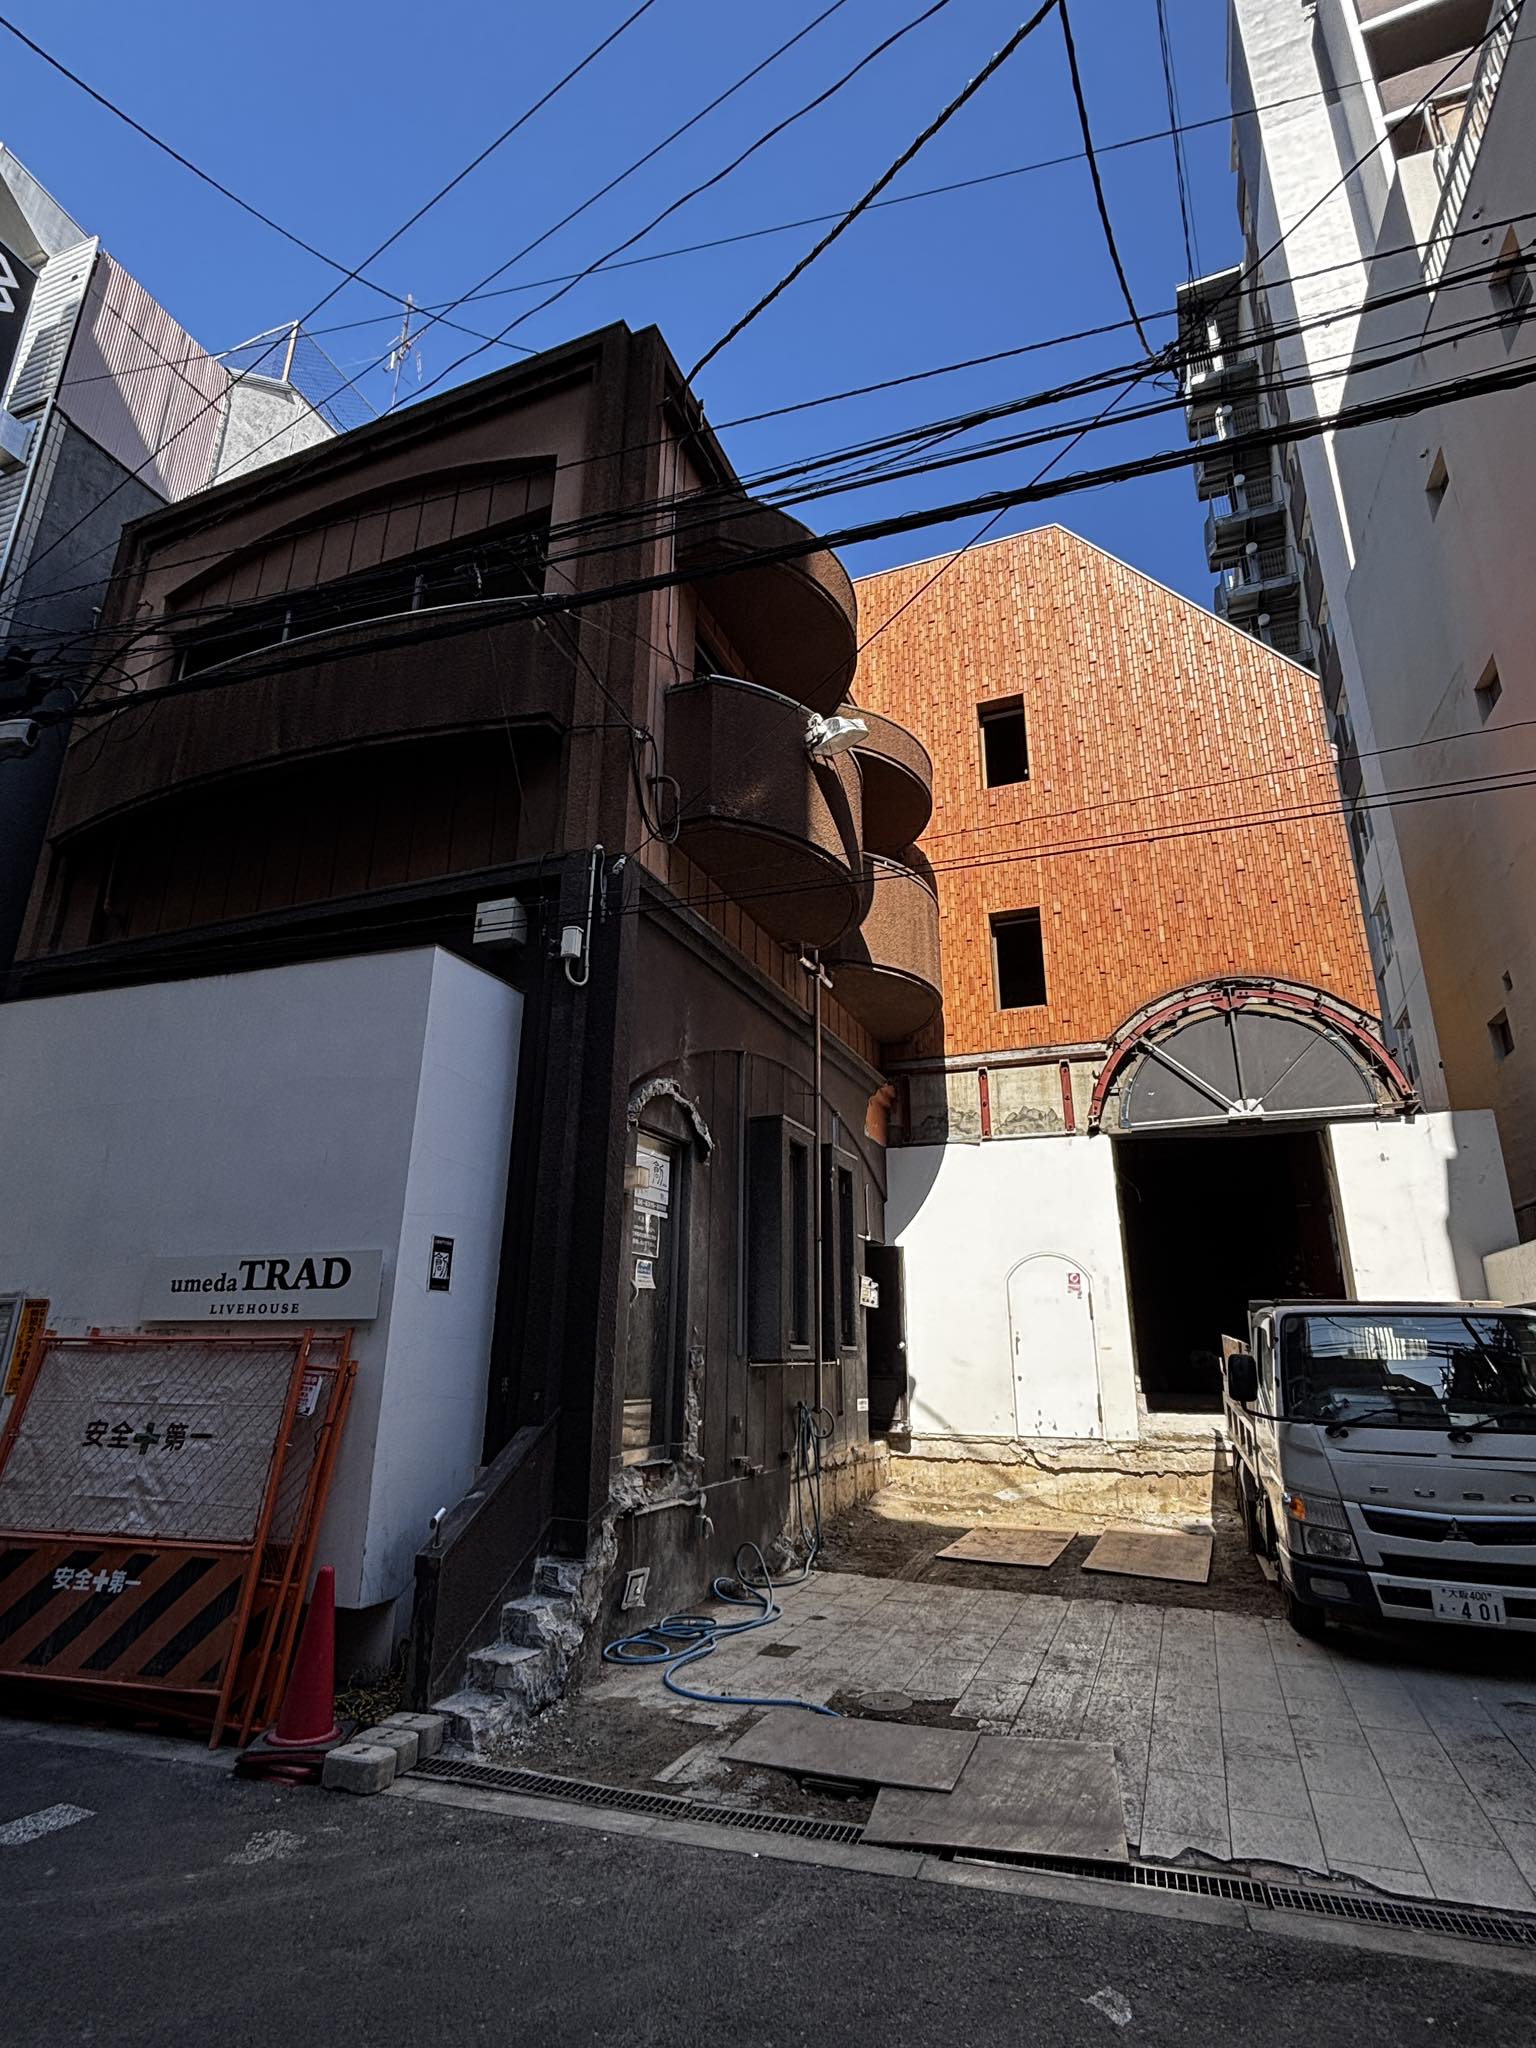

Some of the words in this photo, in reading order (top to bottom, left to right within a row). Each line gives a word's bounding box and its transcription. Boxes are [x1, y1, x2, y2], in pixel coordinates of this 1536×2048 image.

[170, 1273, 237, 1293] umeda
[238, 1256, 352, 1291] TRAD
[208, 1303, 300, 1315] LIVEHOUSE
